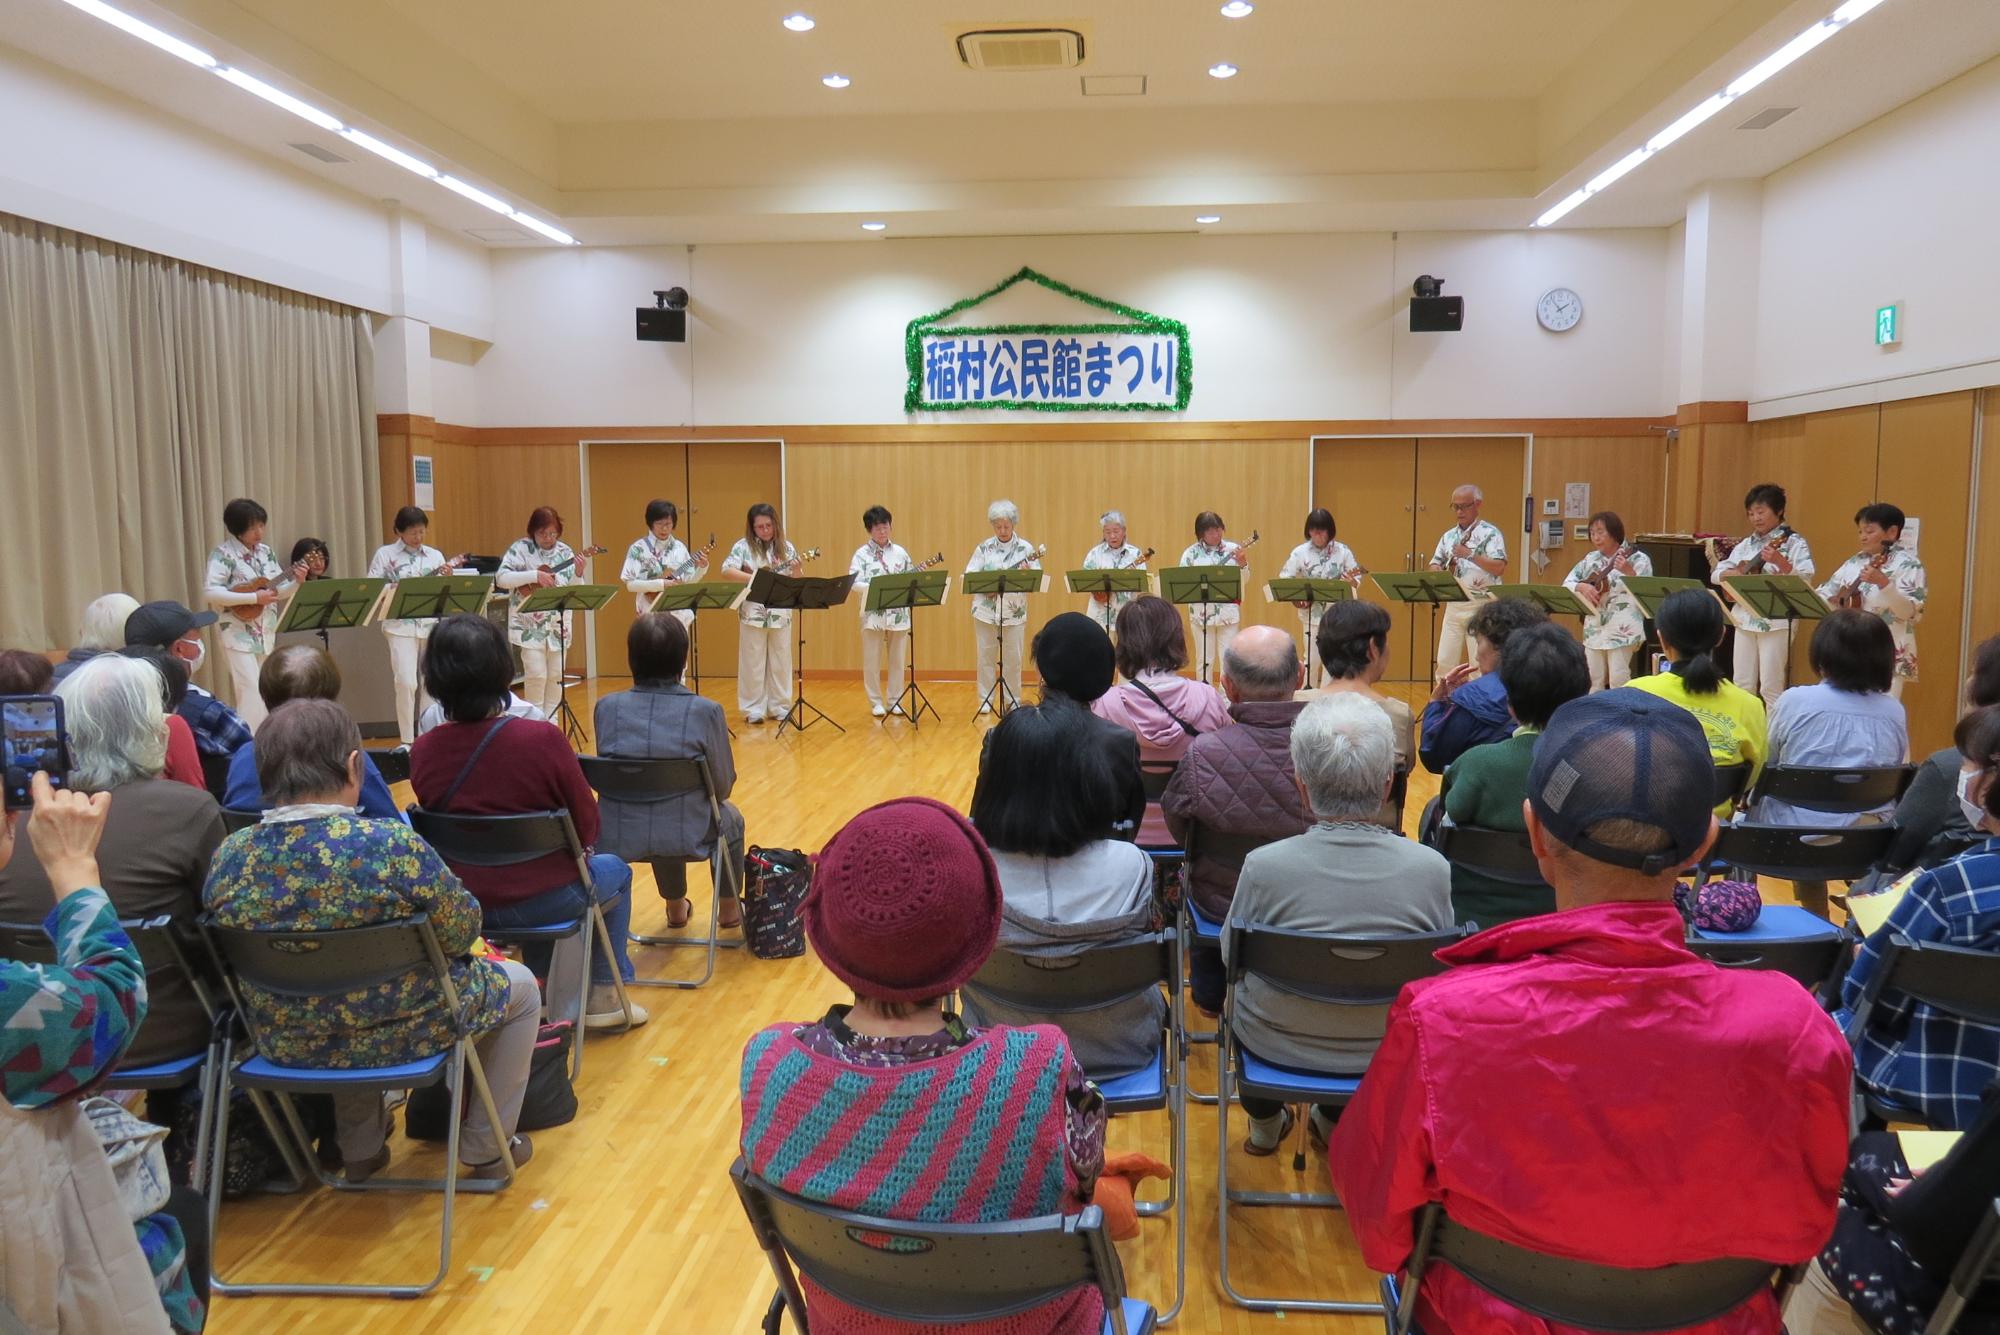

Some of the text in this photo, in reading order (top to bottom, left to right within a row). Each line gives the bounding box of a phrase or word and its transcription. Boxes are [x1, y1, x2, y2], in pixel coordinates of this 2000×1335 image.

[926, 338, 1173, 401] 稲村公民館まつり
